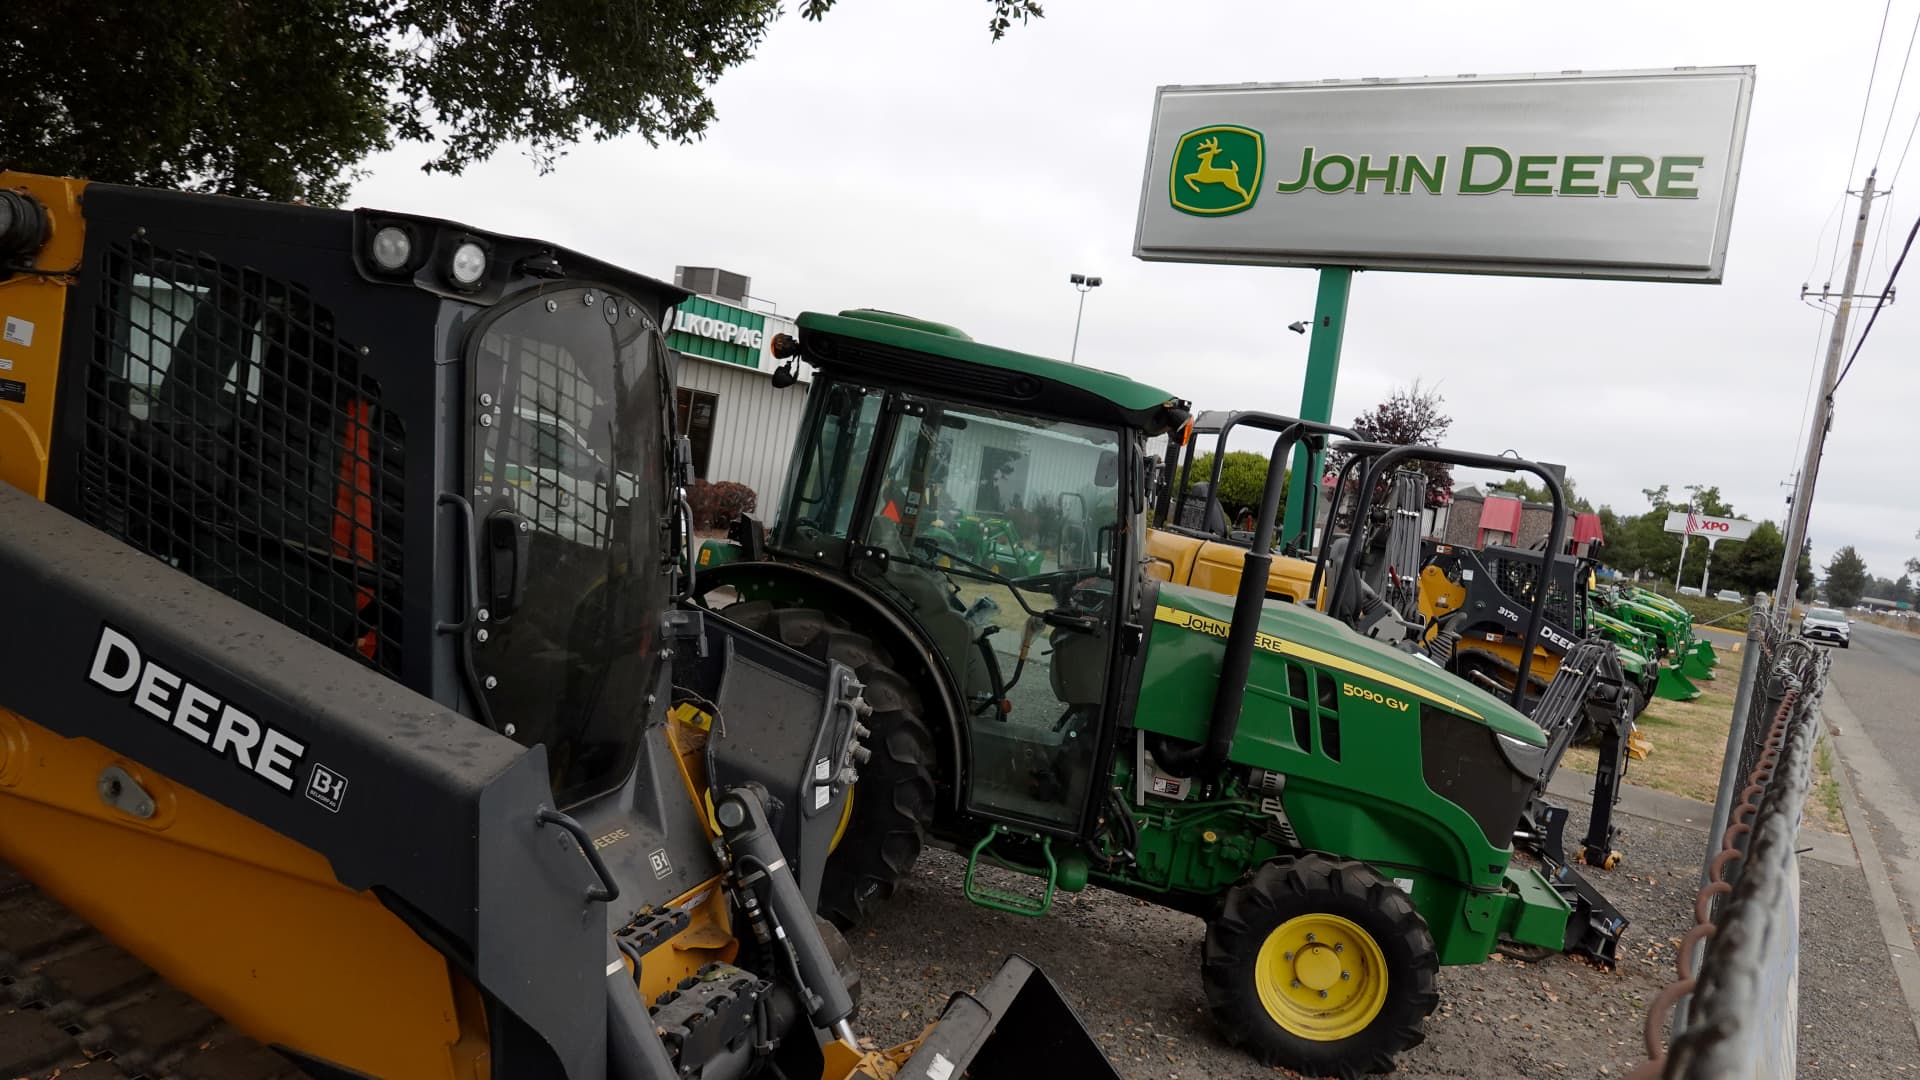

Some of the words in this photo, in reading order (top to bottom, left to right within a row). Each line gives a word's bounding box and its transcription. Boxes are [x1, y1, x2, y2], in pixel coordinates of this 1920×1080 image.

[1276, 146, 1448, 195] JOHN
[1457, 145, 1704, 199] DEERE
[1702, 520, 1729, 532] XPO
[1182, 615, 1226, 636] JOHN
[1497, 606, 1519, 621] 317G
[89, 626, 304, 791] DEERE
[1343, 682, 1384, 704] 5090
[1385, 697, 1409, 712] GV
